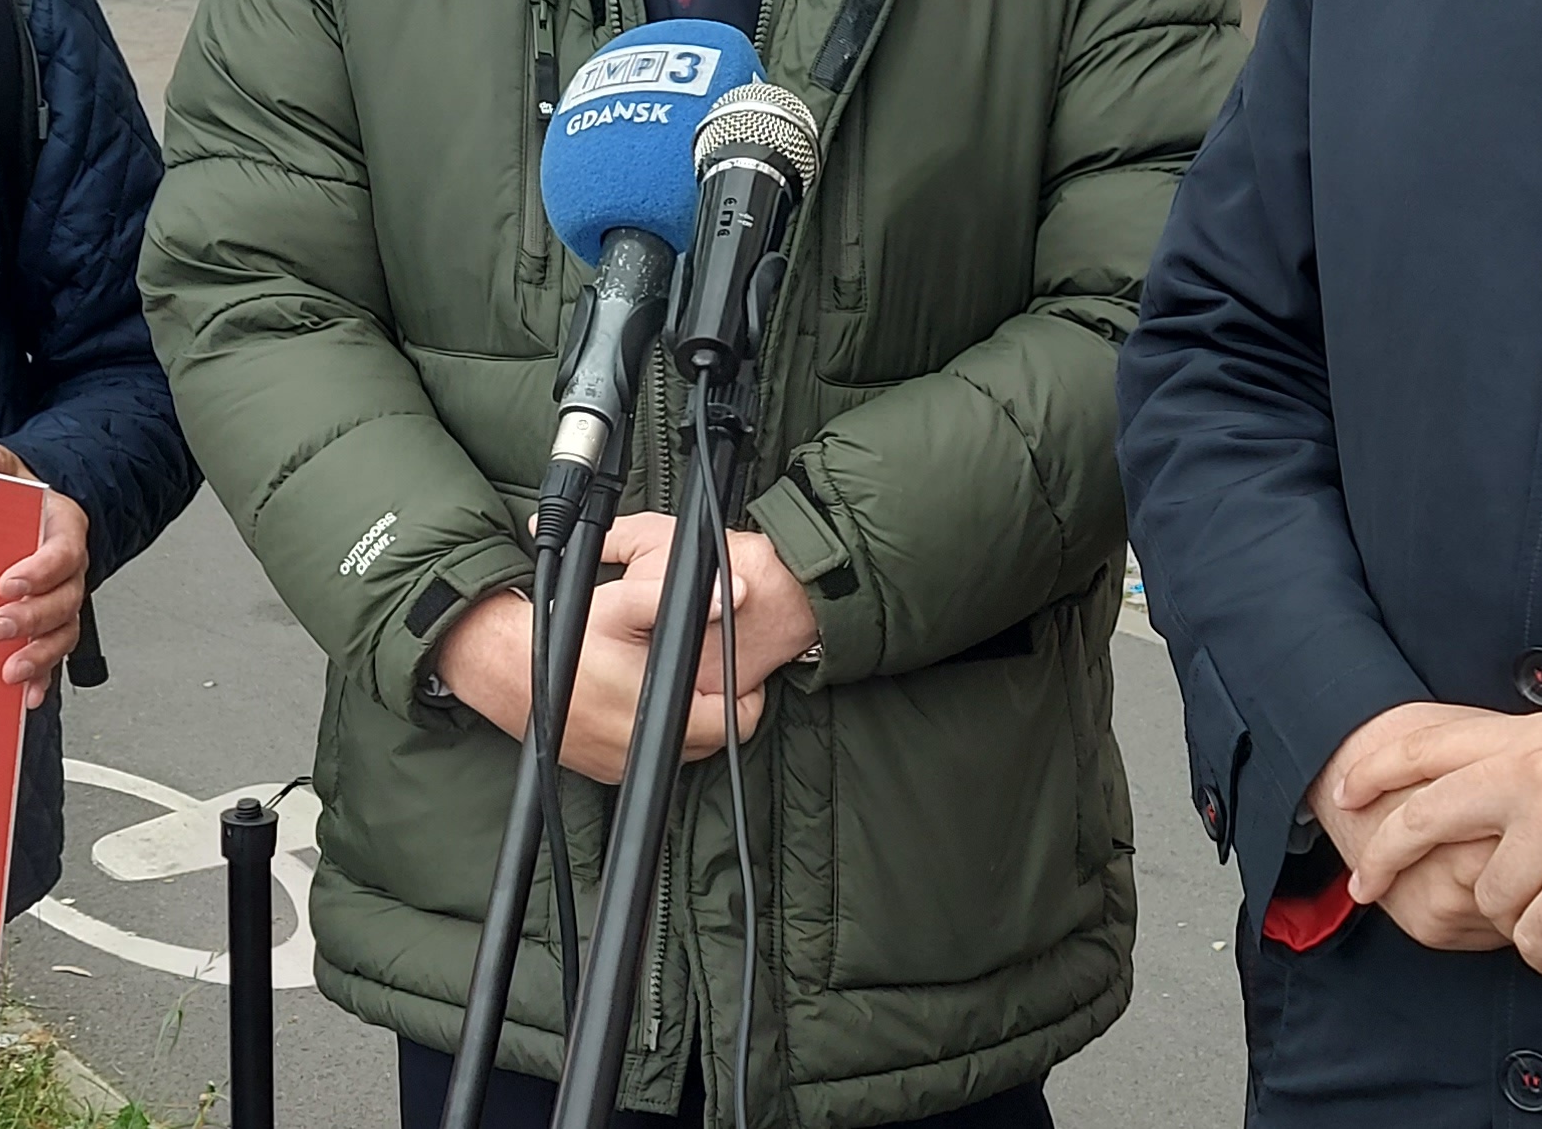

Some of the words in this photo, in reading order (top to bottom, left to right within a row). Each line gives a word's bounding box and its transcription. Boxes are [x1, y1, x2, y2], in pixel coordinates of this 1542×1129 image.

[580, 55, 659, 92] TVP
[668, 51, 703, 85] 3
[339, 511, 398, 576] OUTDOORS
